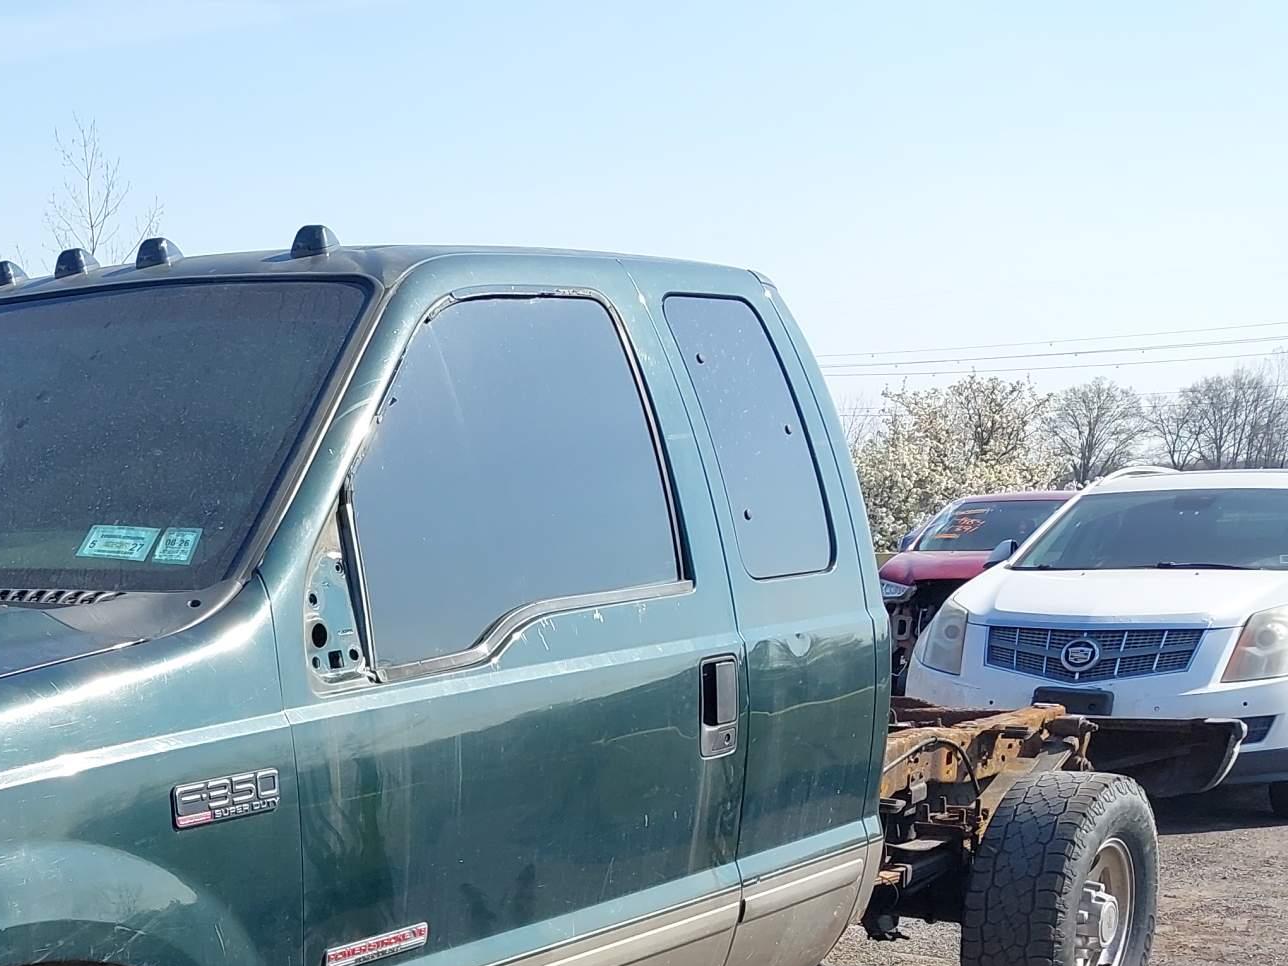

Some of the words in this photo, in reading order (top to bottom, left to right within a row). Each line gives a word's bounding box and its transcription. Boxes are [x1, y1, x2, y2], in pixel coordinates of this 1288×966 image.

[128, 543, 145, 553] 27
[175, 767, 279, 816] F-350
[214, 803, 250, 819] SUPER
[252, 796, 280, 811] DUTY
